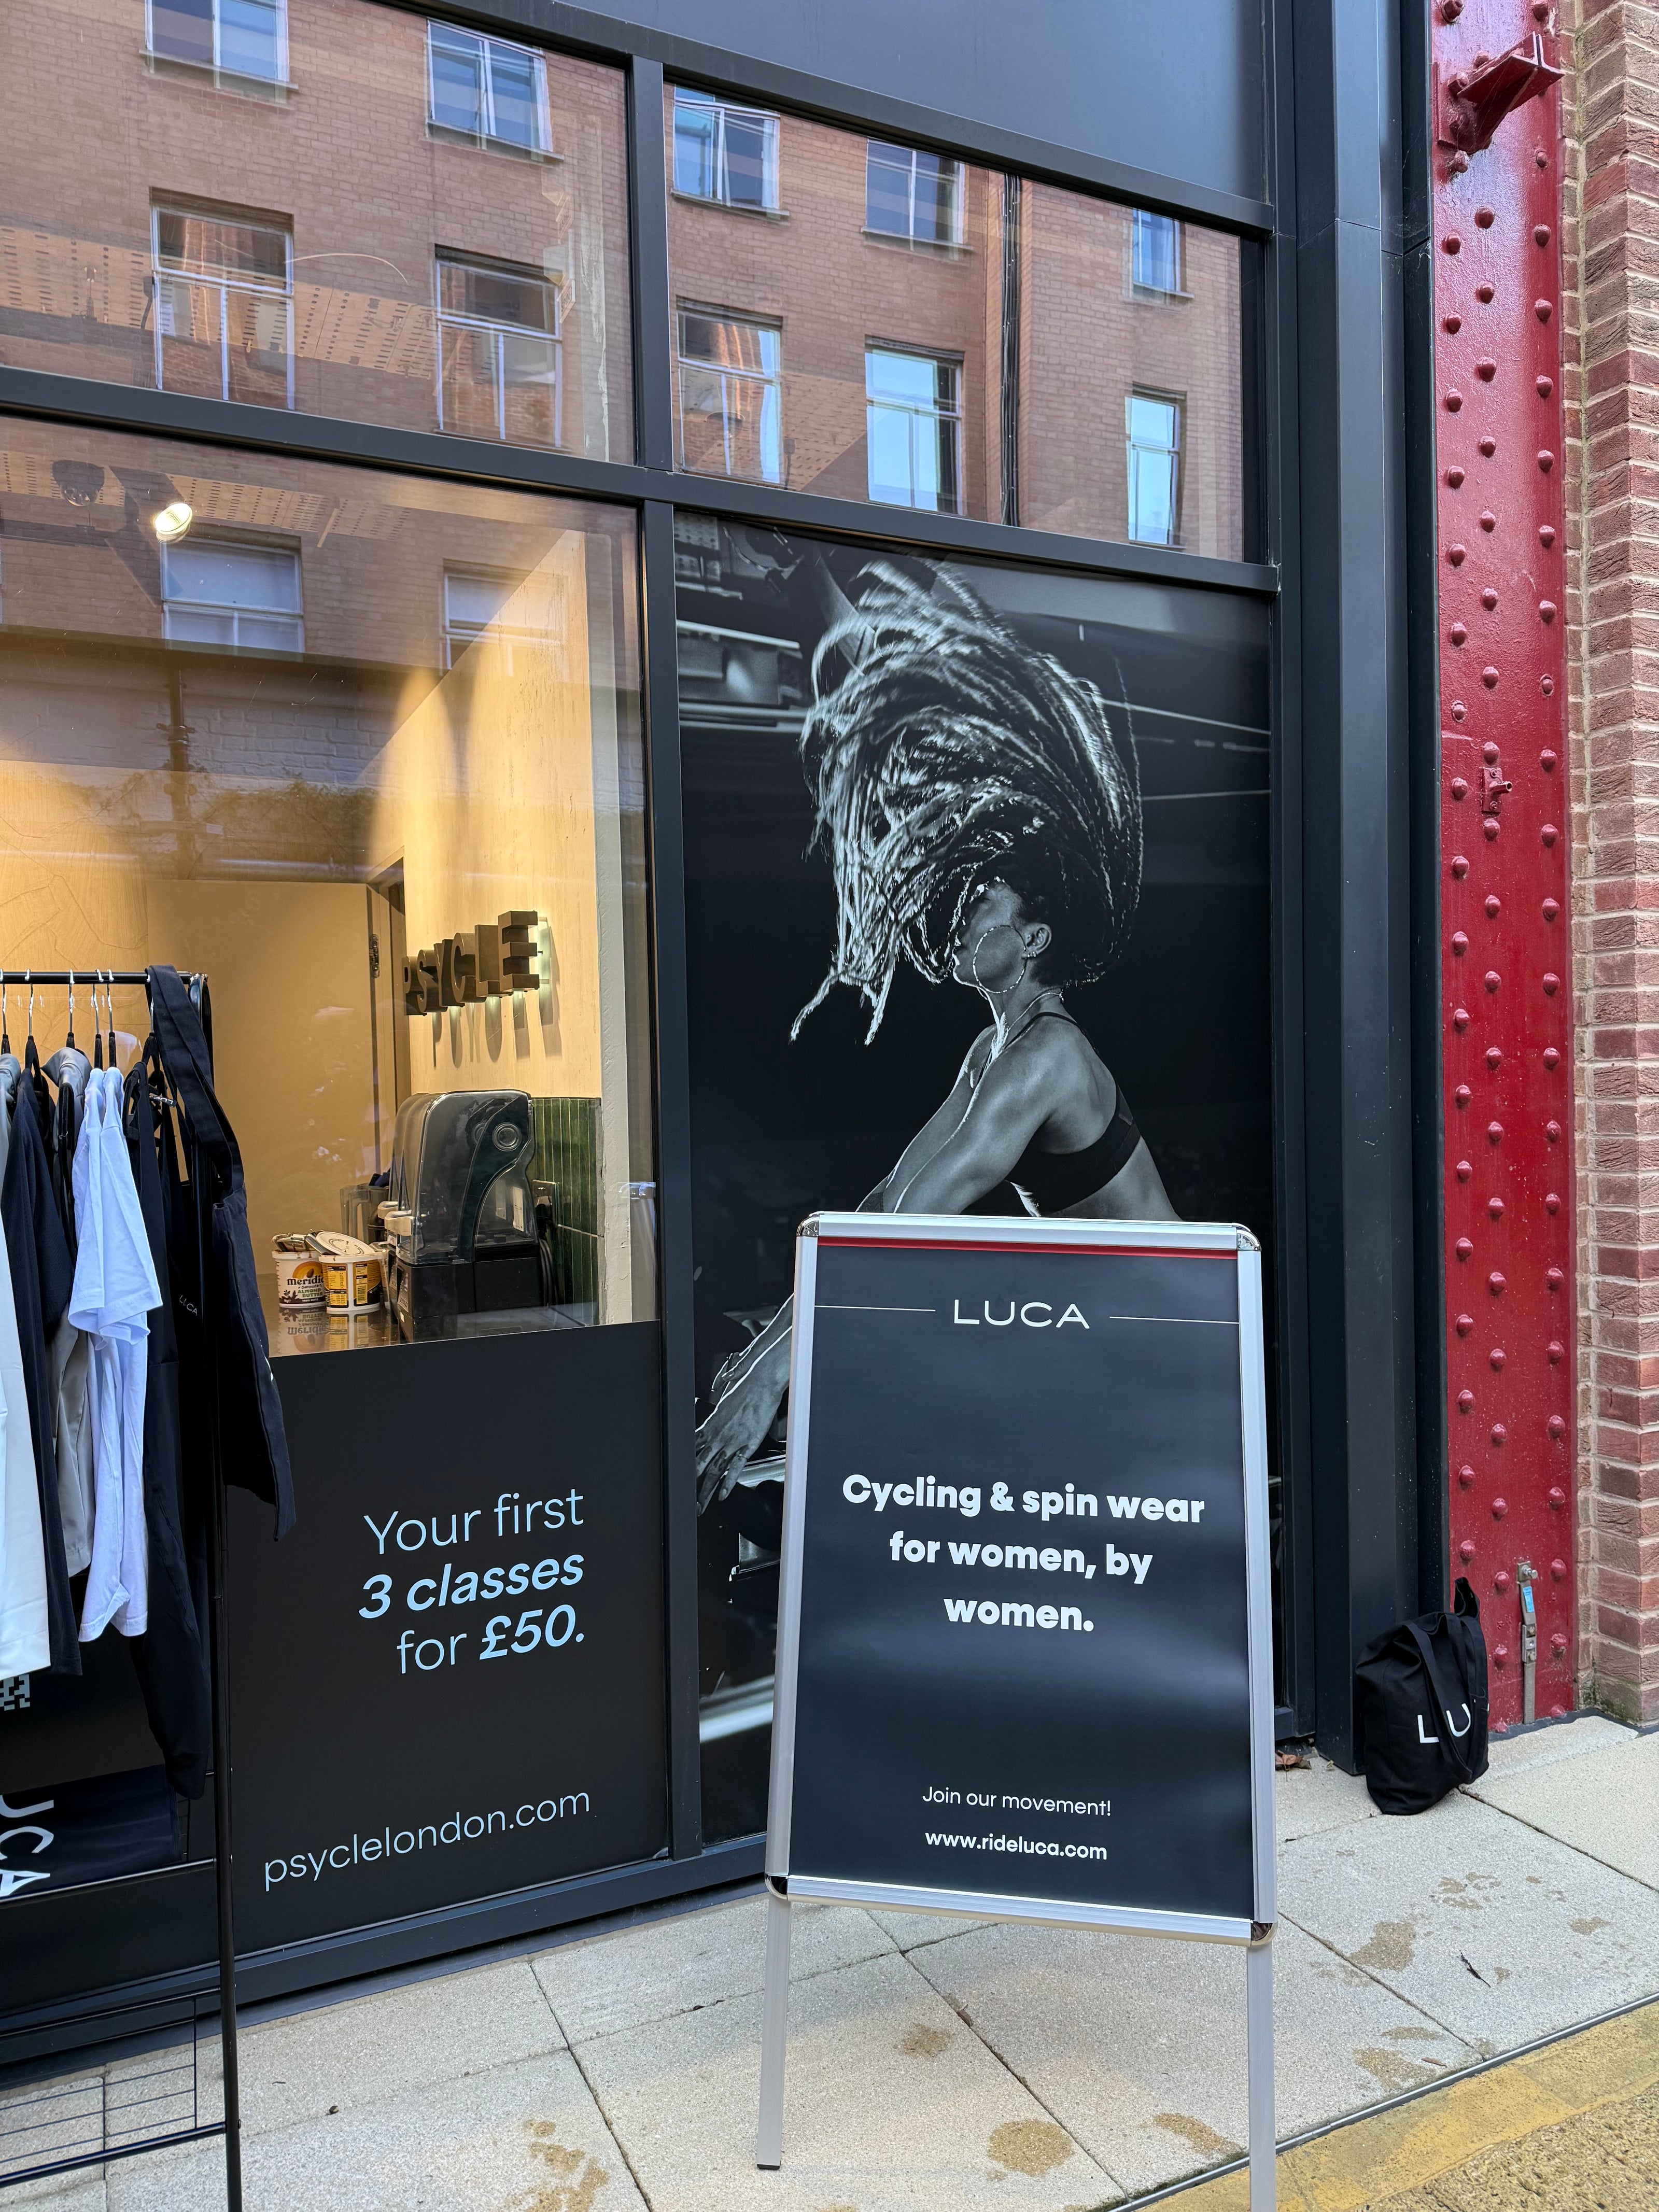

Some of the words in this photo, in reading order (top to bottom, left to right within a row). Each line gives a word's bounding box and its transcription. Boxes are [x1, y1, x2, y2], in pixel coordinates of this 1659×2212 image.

[402, 910, 540, 1016] PSYCLE
[954, 1299, 1090, 1329] LUCA
[363, 1510, 481, 1555] Your
[494, 1488, 584, 1537] first
[842, 1474, 981, 1517] Cycling
[990, 1481, 1015, 1512] &
[1022, 1483, 1098, 1521] spin
[1106, 1495, 1205, 1523] wear
[889, 1530, 940, 1563] for
[947, 1542, 1096, 1580] women,
[1106, 1543, 1154, 1584] by
[358, 1574, 393, 1619] 3
[406, 1554, 584, 1611] classes
[396, 1630, 467, 1674] for
[479, 1604, 585, 1660] £50.
[943, 1598, 1094, 1632] women.
[1417, 1703, 1471, 1743] LU
[922, 1786, 961, 1805] Join
[966, 1793, 997, 1807] our
[1002, 1796, 1111, 1816] movement!
[265, 1792, 590, 1892] psyclelondon.com
[925, 1830, 1107, 1860] www.rideluca.com
